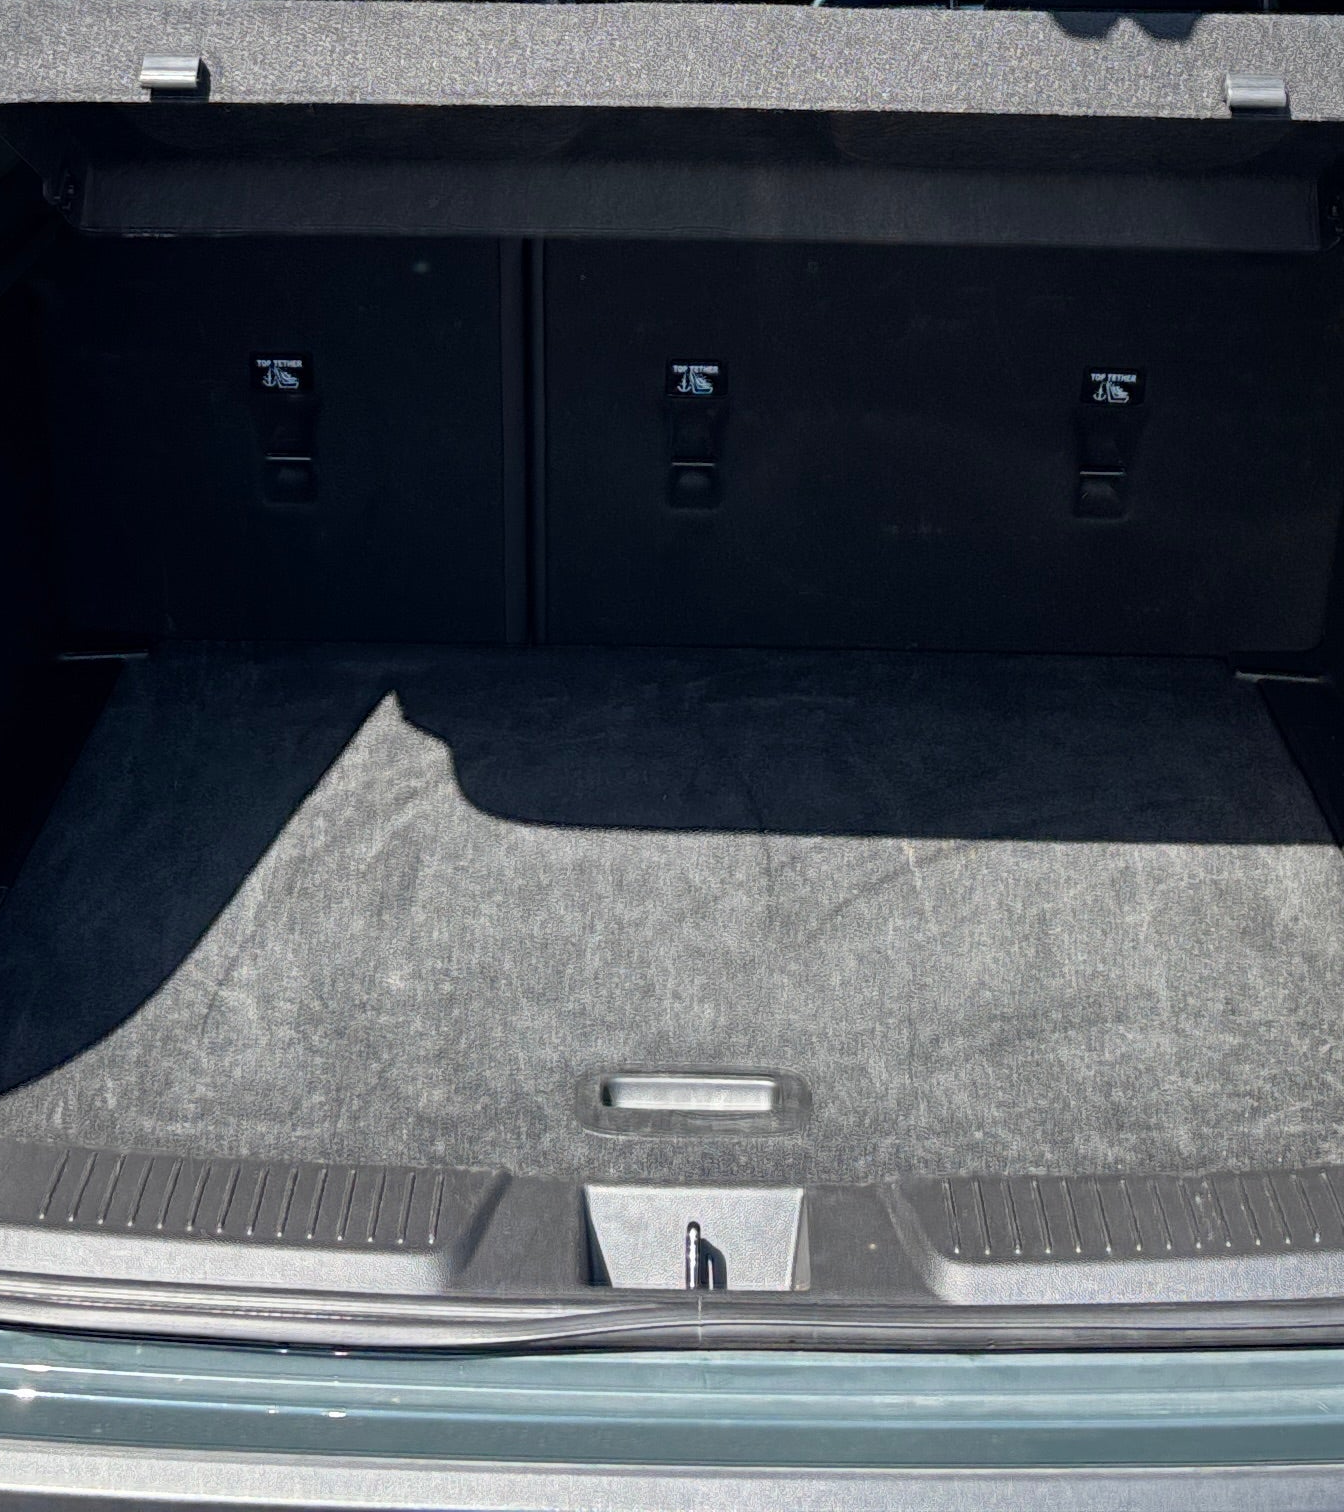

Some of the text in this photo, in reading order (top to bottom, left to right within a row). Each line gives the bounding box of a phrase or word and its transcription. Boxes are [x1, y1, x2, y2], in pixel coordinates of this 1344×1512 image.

[257, 359, 302, 368] TOP TETHER
[672, 365, 688, 373] TOP
[1090, 373, 1106, 381] TOP
